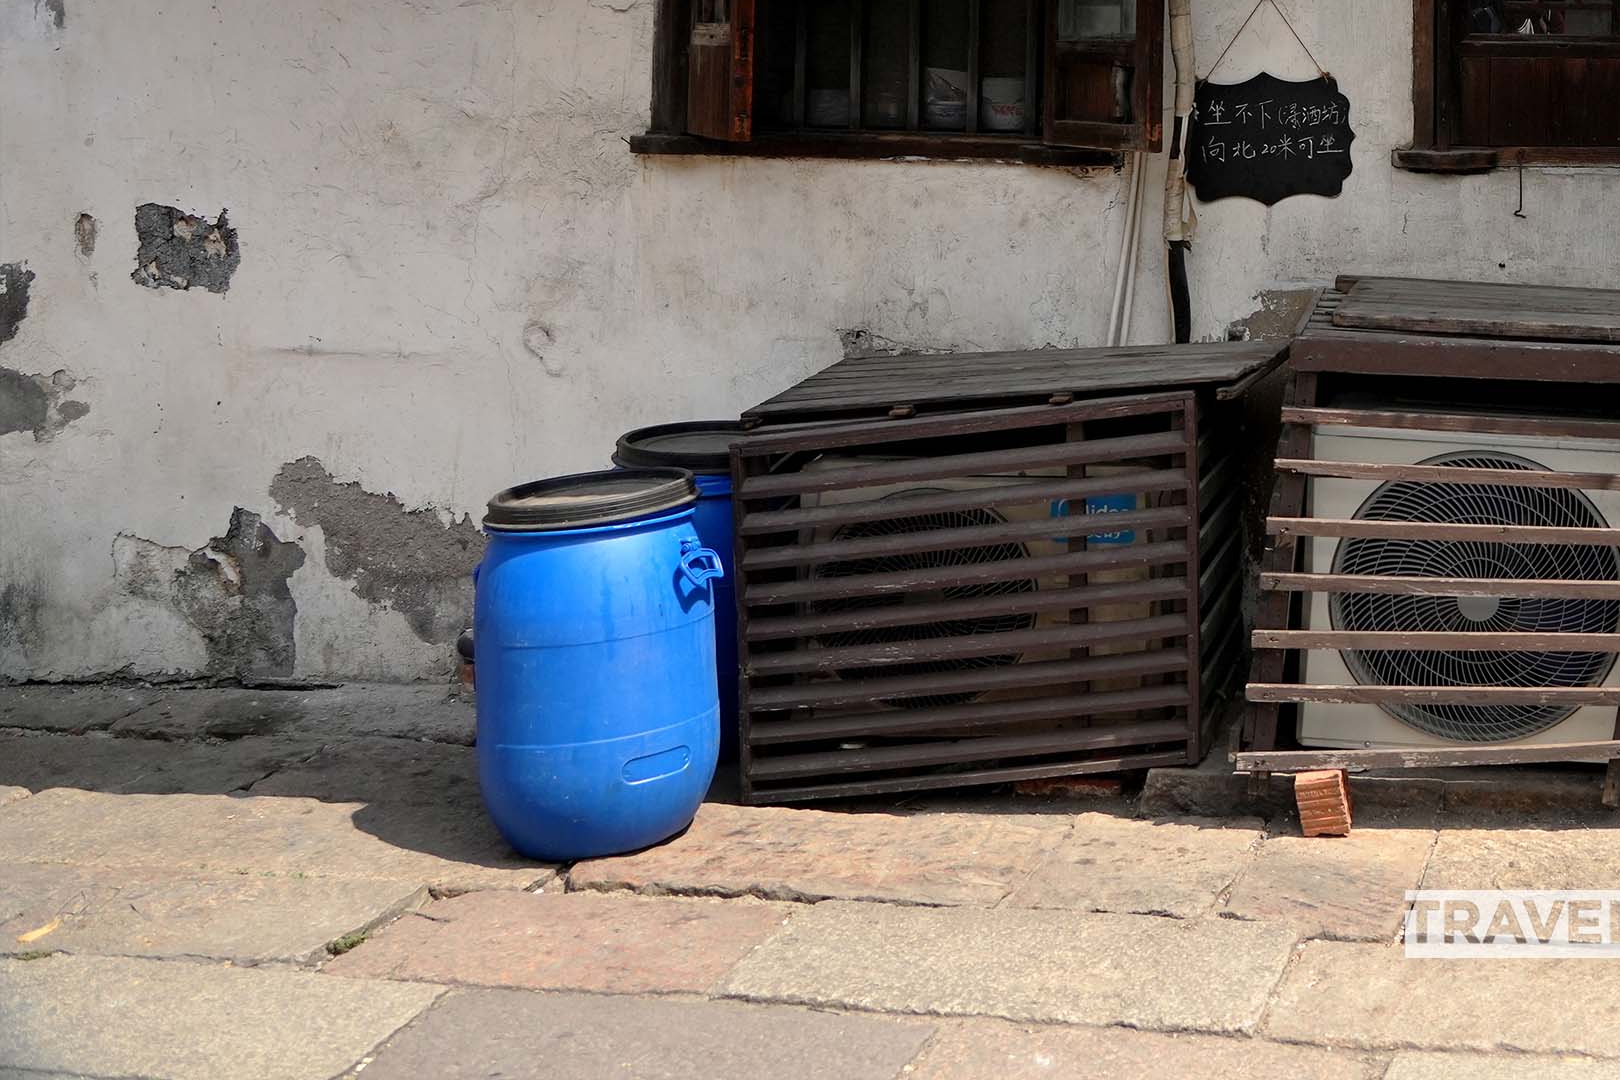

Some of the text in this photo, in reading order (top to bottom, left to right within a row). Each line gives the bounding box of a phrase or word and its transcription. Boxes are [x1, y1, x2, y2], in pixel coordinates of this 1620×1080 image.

[1202, 134, 1344, 164] 向北20米可坐
